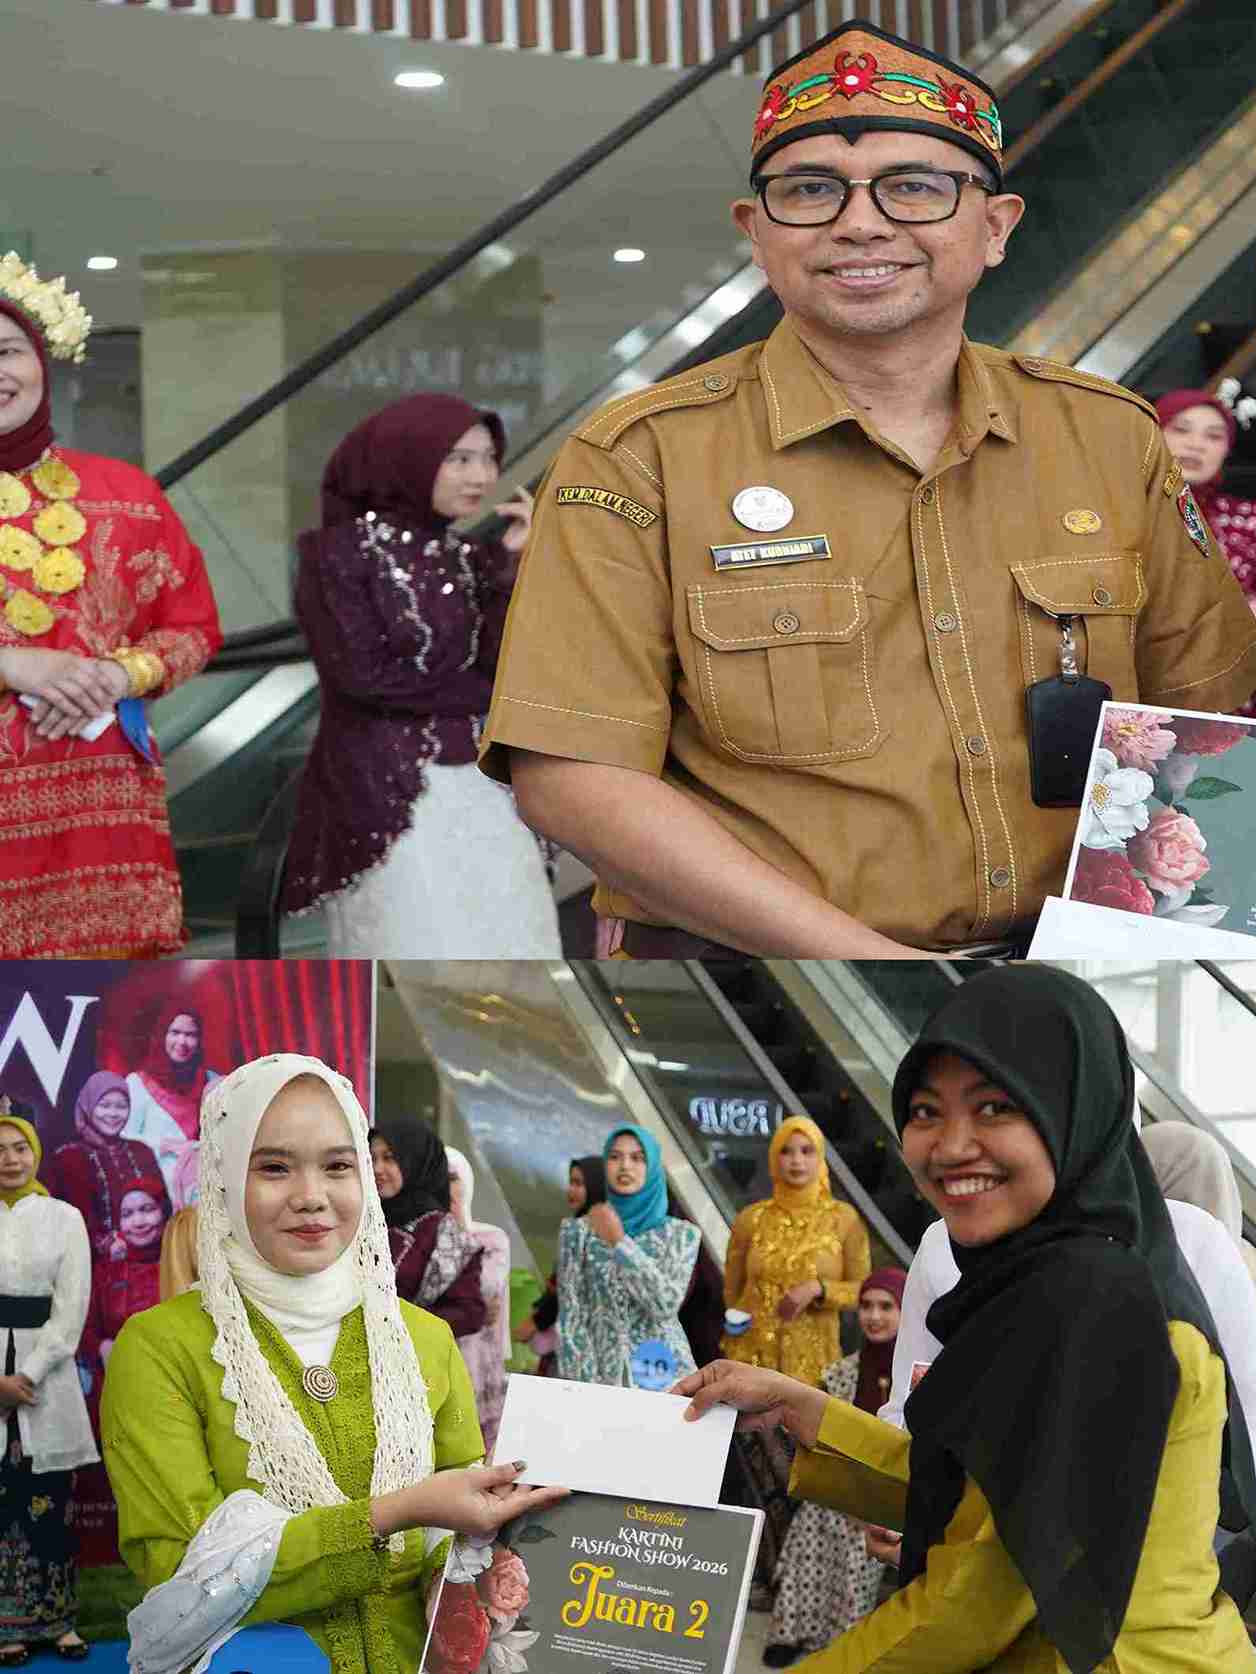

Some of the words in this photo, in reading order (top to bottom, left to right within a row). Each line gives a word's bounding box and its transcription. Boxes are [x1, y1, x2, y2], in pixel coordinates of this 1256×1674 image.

[570, 1536, 643, 1564] FASHION
[643, 1550, 693, 1569] SHOW
[692, 1559, 728, 1575] 2026
[618, 1527, 684, 1551] KARTINI
[561, 1562, 675, 1633] Juara
[684, 1600, 710, 1639] 2
